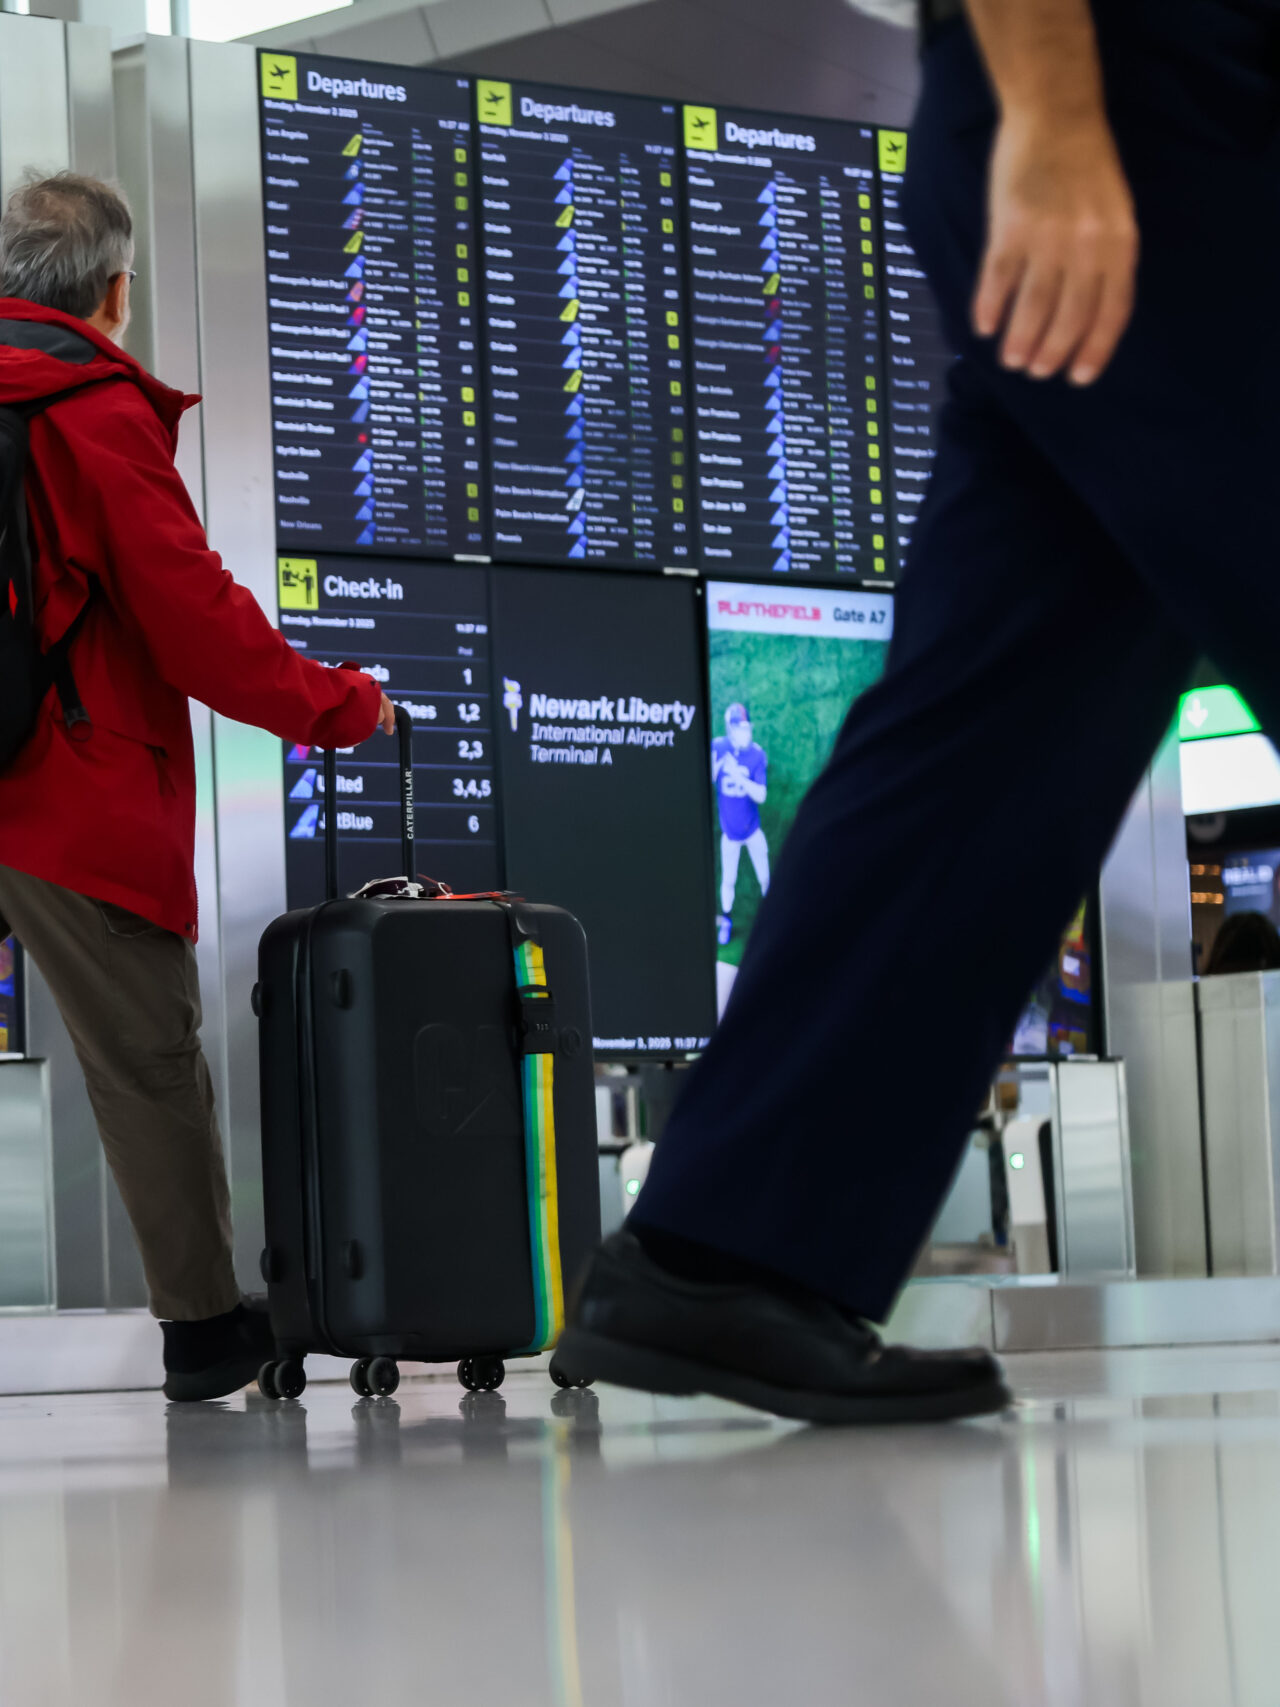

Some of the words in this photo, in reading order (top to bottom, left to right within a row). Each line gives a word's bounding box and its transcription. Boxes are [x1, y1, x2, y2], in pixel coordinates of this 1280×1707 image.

[307, 71, 407, 102] Departures
[520, 97, 616, 128] Departures
[725, 122, 816, 152] Departures
[324, 575, 403, 601] Check-in
[833, 608, 865, 623] Gate
[870, 610, 886, 624] A7
[457, 646, 473, 656] Pod
[462, 668, 472, 685] 1
[457, 703, 480, 723] 1,2
[530, 694, 615, 721] Newark
[617, 697, 696, 731] Liberty
[532, 723, 625, 745] International
[627, 727, 675, 749] Airport
[458, 740, 483, 760] 2,3
[530, 745, 598, 764] Terminal
[600, 749, 613, 765] A
[317, 775, 363, 794] Uited
[453, 778, 491, 799] 3,4,5
[405, 771, 414, 839] CATERPILLAR
[318, 813, 373, 831] JtBlue
[468, 815, 479, 833] 6
